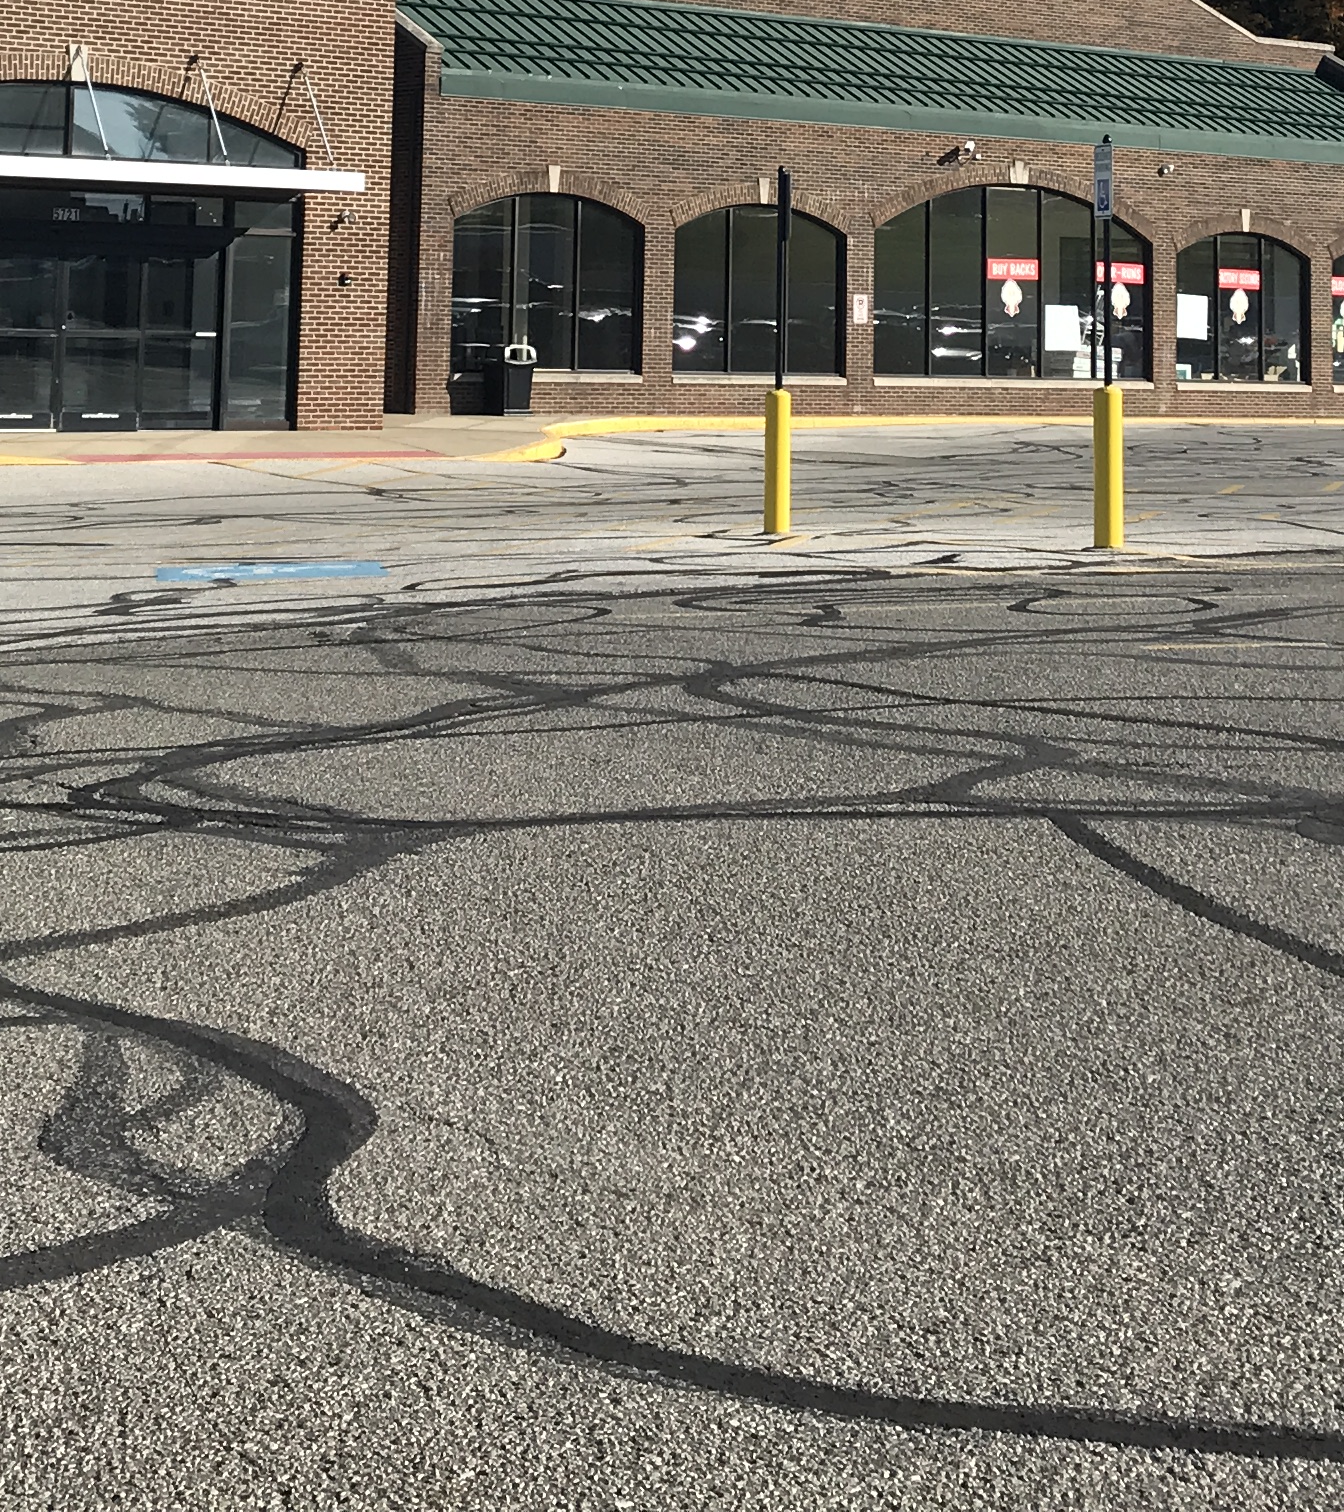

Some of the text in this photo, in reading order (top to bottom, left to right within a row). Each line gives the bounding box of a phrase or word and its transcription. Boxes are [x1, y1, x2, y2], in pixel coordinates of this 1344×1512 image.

[53, 208, 80, 221] 5721
[992, 262, 1036, 276] BUY BACKS
